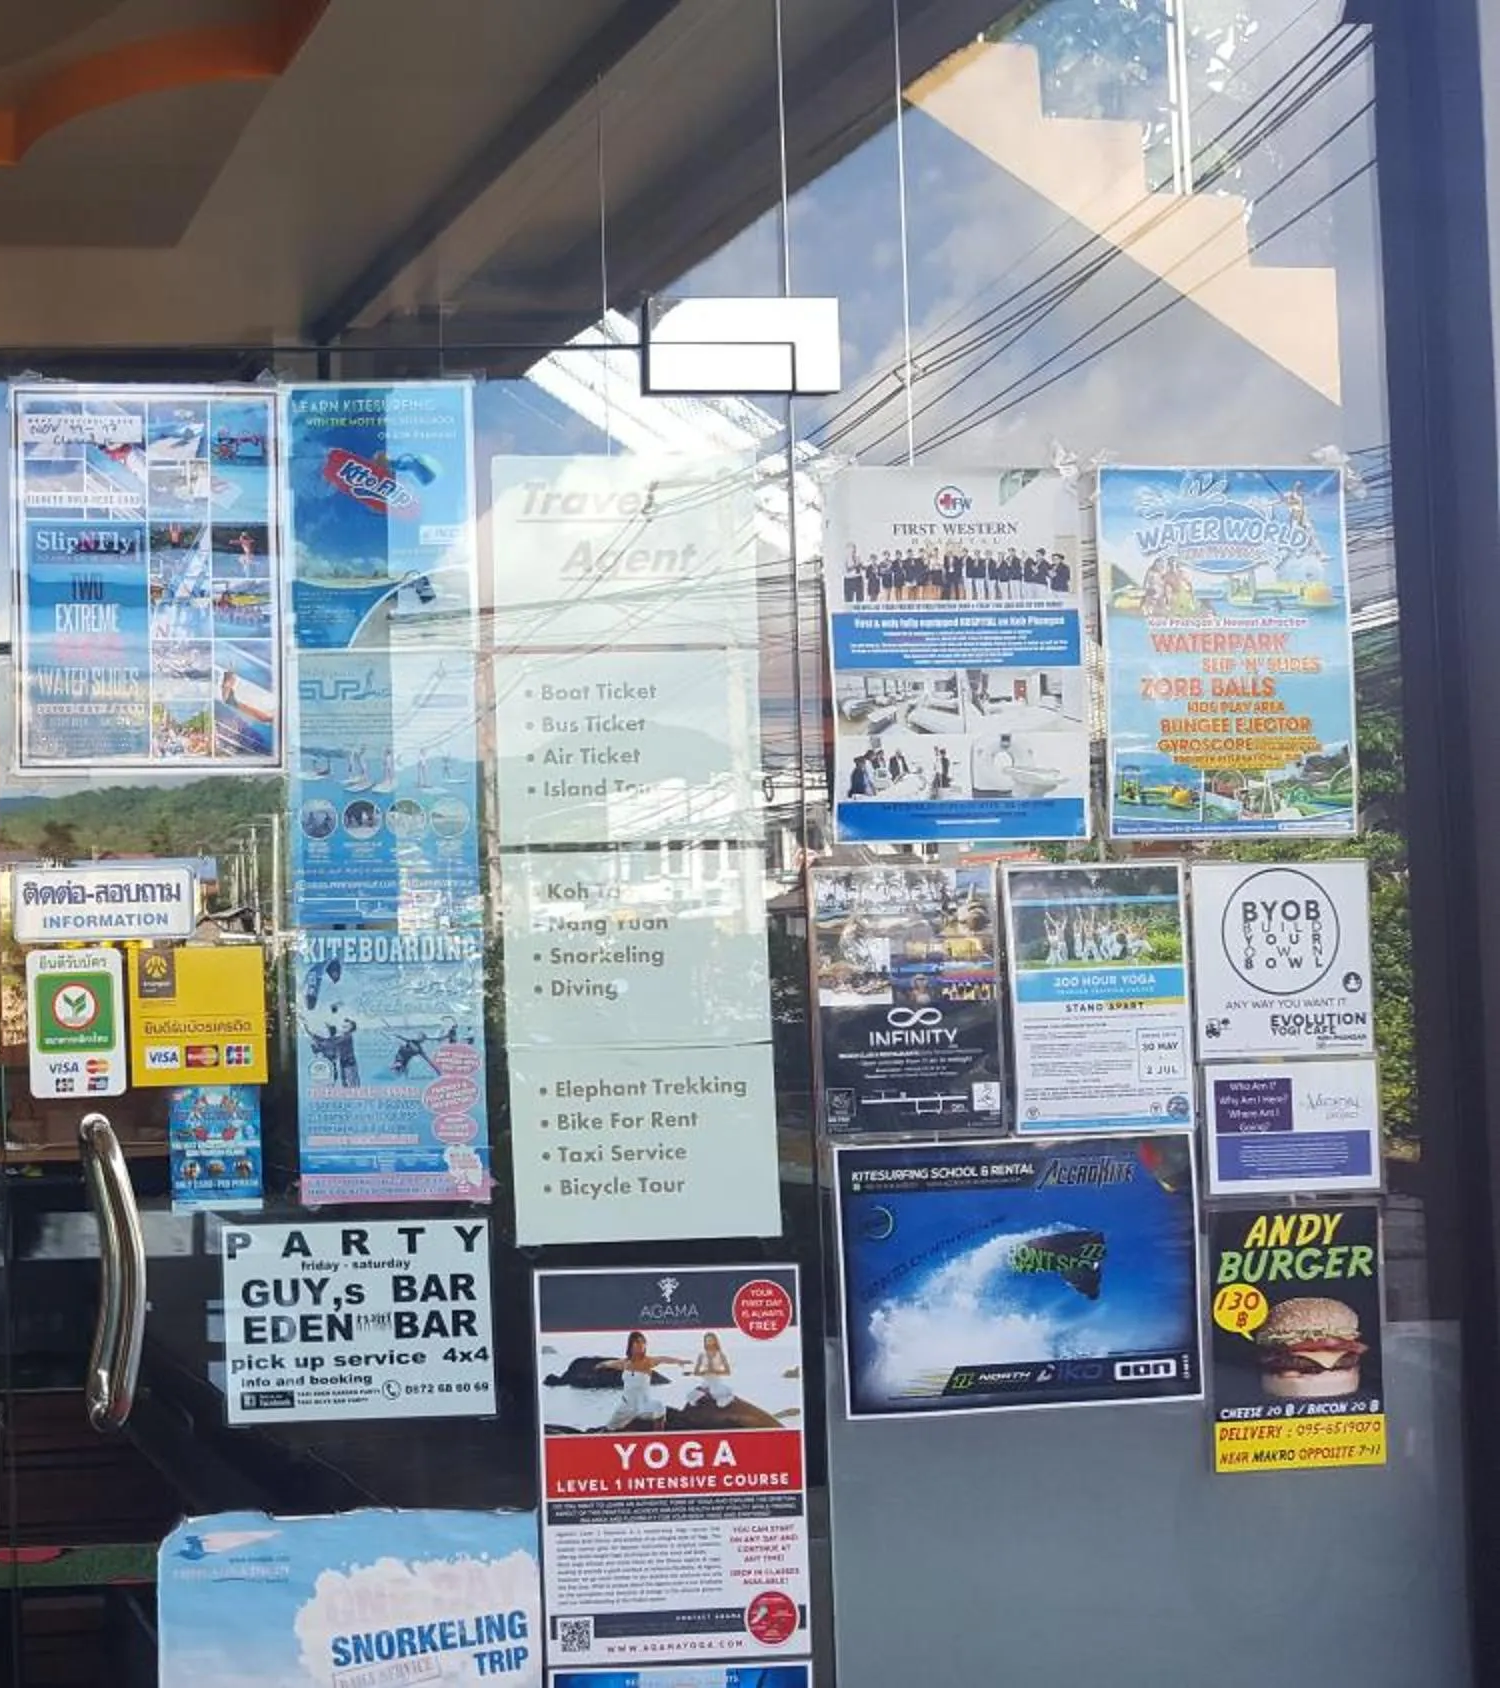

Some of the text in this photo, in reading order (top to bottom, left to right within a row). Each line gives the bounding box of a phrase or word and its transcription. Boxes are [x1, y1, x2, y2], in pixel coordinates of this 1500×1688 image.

[292, 400, 339, 413] LEARN
[893, 521, 1017, 537] FIRST WESTERN
[1136, 517, 1309, 552] WATER WORLD
[560, 541, 694, 578] Agent
[71, 574, 104, 601] TWO
[54, 603, 120, 632] EXTREME
[1151, 632, 1290, 653] WATERPARK
[541, 683, 657, 700] Boat Ticket
[1141, 677, 1276, 698] ZORB BALLS
[542, 716, 645, 733] Bus Ticket
[1160, 717, 1312, 734] BUNGEE EJECTOR
[1157, 738, 1252, 751] GYROSCOPE
[543, 749, 640, 765] Air Ticket
[544, 783, 606, 797] Island
[23, 881, 181, 906] ติดต่อ-สอบถาม
[548, 883, 589, 900] Koh
[1242, 900, 1321, 921] BYOB
[43, 912, 169, 929] INFORMATION
[302, 935, 477, 964] KITEBOARDING
[550, 946, 665, 966] Snorkeling
[1082, 976, 1117, 986] HOUR
[1122, 975, 1156, 984] YOGA
[551, 980, 619, 1001] Diving
[1226, 997, 1347, 1010] ANY WAY YOU WANT IT
[1270, 1012, 1366, 1026] EVOLUTION
[869, 1028, 958, 1046] INFINITY
[1271, 1026, 1336, 1036] YOGI CAFE
[149, 1050, 178, 1063] VISA
[49, 1061, 79, 1074] VISA
[1157, 1065, 1178, 1074] JUL
[555, 1077, 747, 1102] Elephant Trekking
[1229, 1082, 1268, 1091] Who Am
[1220, 1098, 1239, 1107] Why
[557, 1112, 698, 1130] Bike For Rent
[557, 1144, 687, 1162] Taxi Service
[852, 1168, 928, 1182] KITESURFING
[931, 1167, 978, 1180] SCHOOL
[991, 1163, 1035, 1176] RENTAL
[560, 1178, 685, 1200] Bicycle Tour
[1244, 1213, 1344, 1248] ANDY
[300, 1258, 411, 1272] friday saturday
[1217, 1246, 1373, 1284] BURGER
[392, 1273, 477, 1303] BAR
[1218, 1292, 1260, 1311] 130
[640, 1304, 699, 1318] AGAMA
[243, 1310, 478, 1345] EDEN BAR
[750, 1321, 778, 1330] FREE
[231, 1346, 489, 1374] pick up service 4x4
[241, 1375, 372, 1388] info and booking
[978, 1371, 1030, 1381] NORTH
[1220, 1402, 1366, 1419] CHEESE 20 BACON 20
[1220, 1426, 1283, 1441] DELIVERY
[613, 1440, 737, 1471] YOGA
[1220, 1452, 1249, 1464] NEAR
[1252, 1450, 1295, 1462] MAKRO
[1299, 1446, 1355, 1460] OPPOSITE
[557, 1473, 788, 1493] LEVEL 1 INTENSIVE COURSE
[331, 1609, 528, 1667] SNORKELING
[473, 1646, 528, 1675] TRIP
